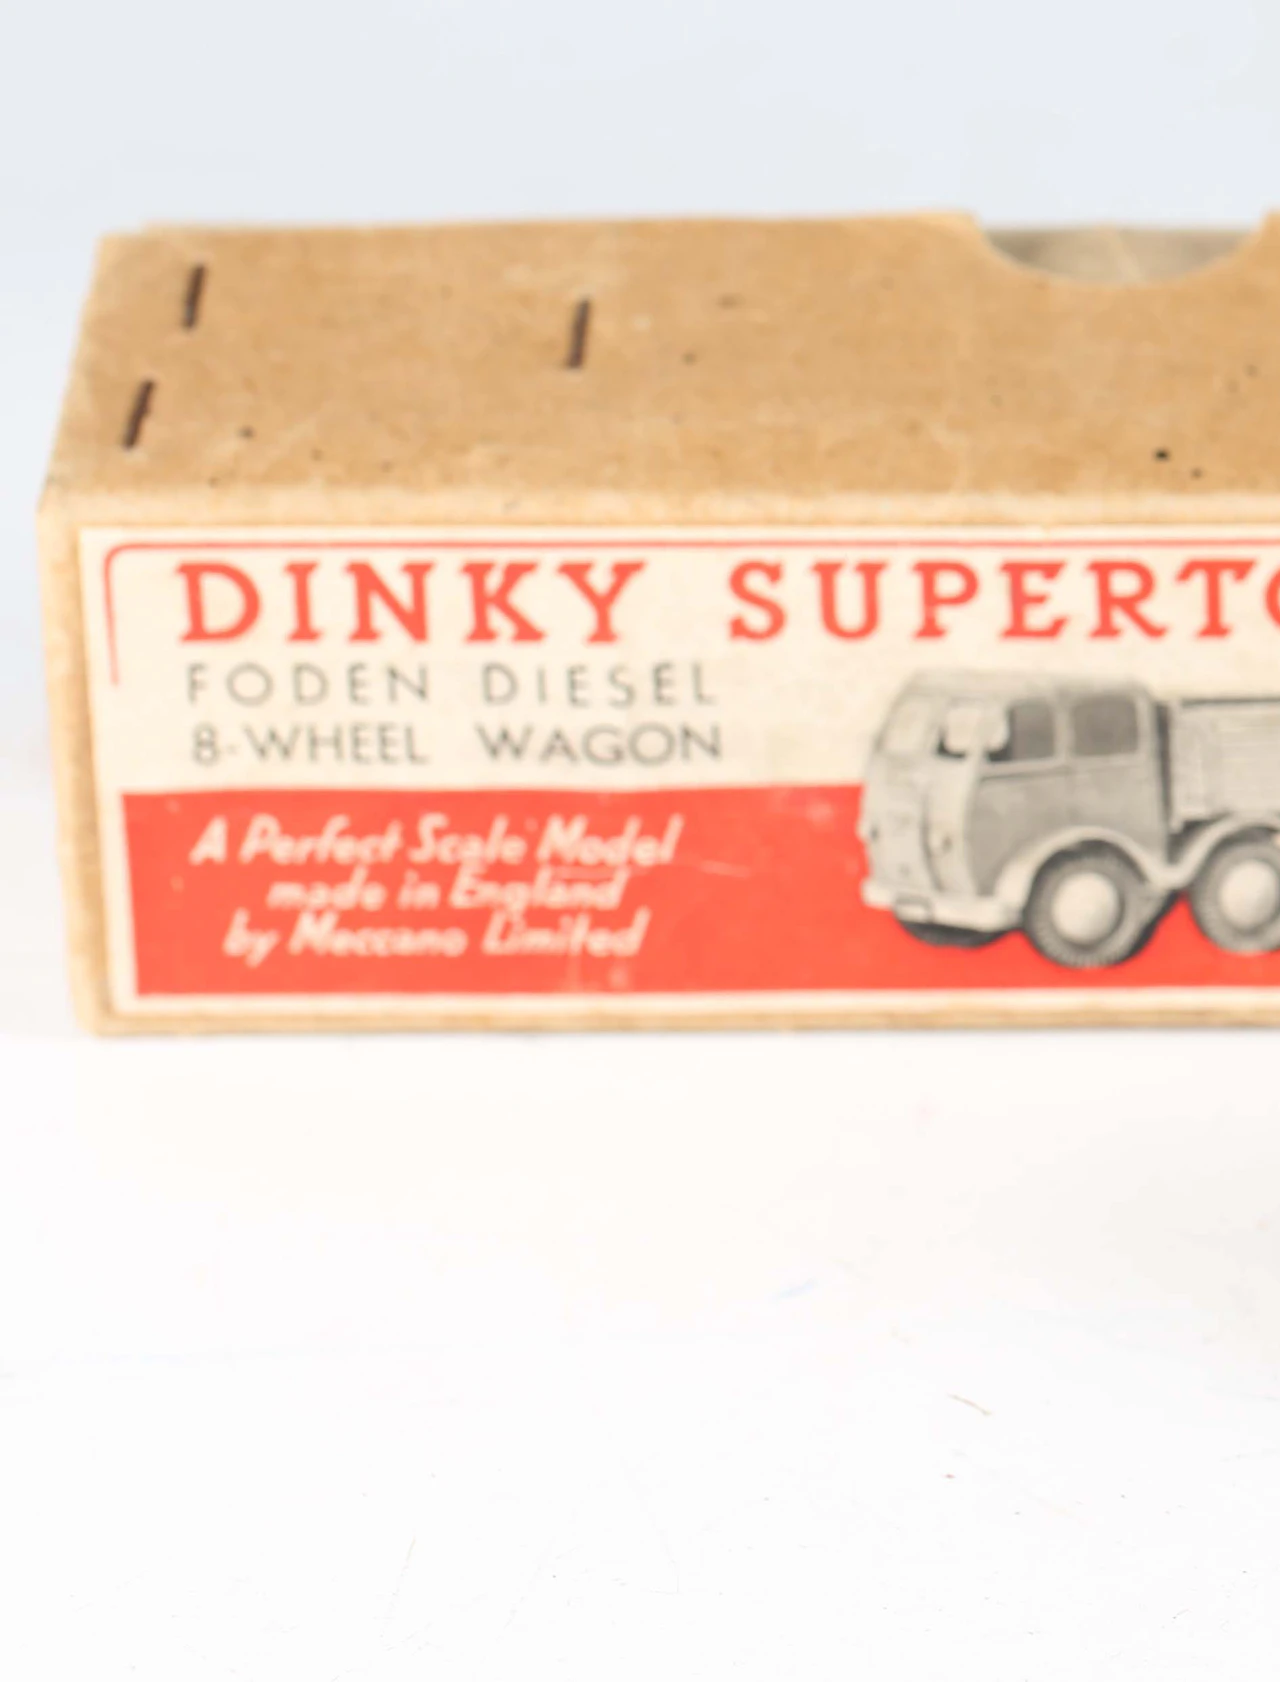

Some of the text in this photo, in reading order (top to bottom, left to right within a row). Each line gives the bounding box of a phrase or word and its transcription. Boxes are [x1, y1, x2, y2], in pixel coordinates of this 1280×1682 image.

[176, 560, 646, 643] DINKY
[187, 659, 718, 708] FODEN DIESEL
[191, 722, 721, 767] 8-WHEEL WAGON
[190, 812, 684, 864] A Perfect Scale Model
[266, 859, 626, 918] made in England
[224, 907, 649, 967] by Meccano Limited
